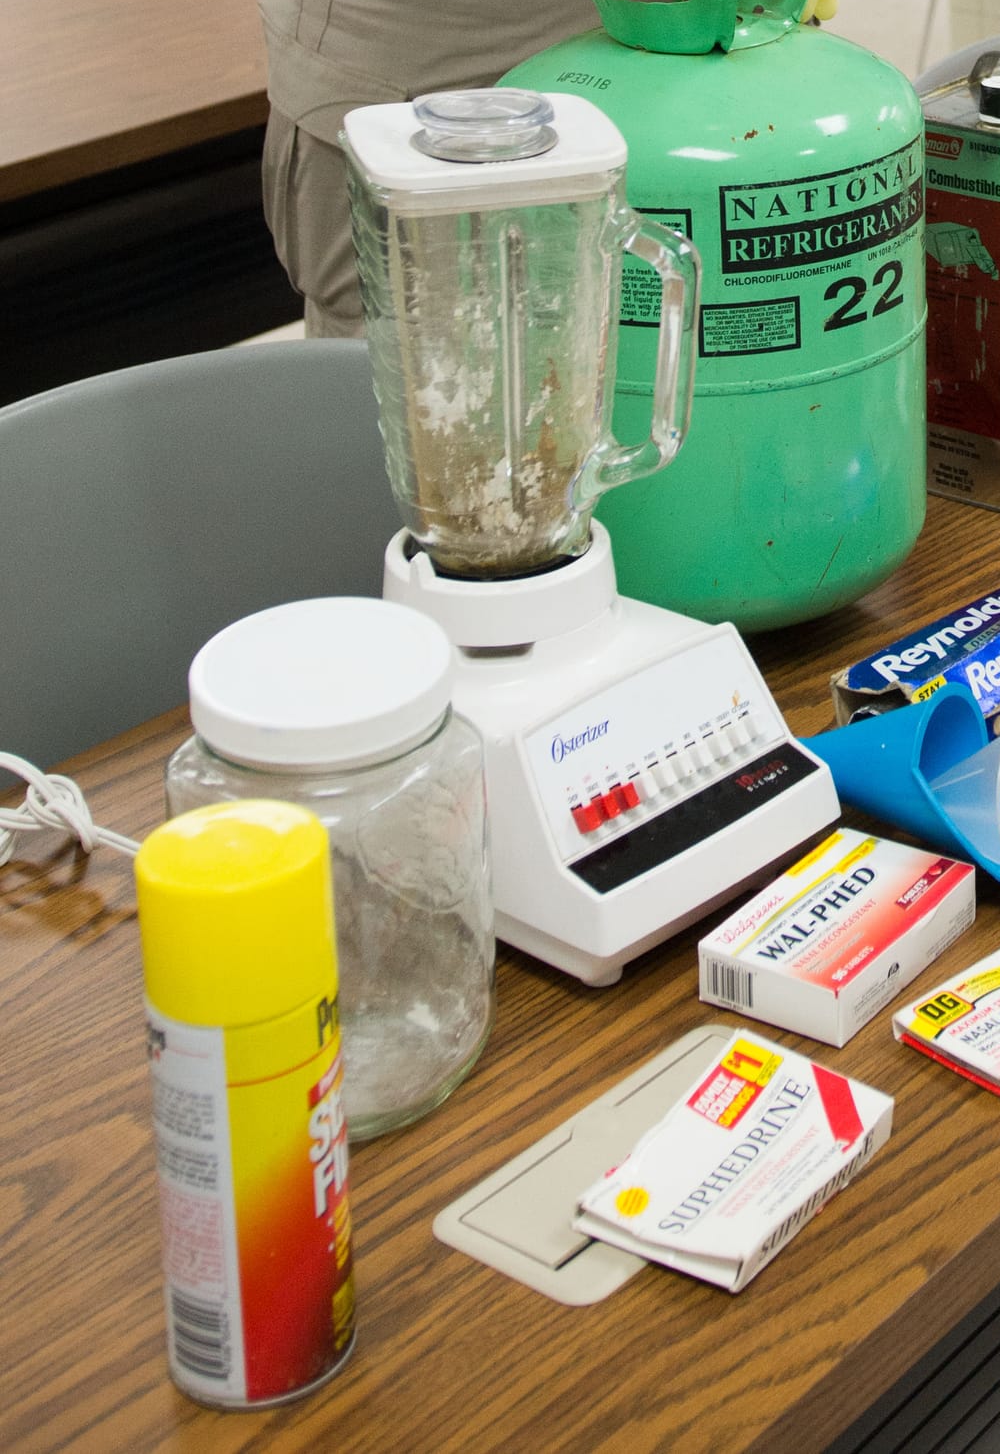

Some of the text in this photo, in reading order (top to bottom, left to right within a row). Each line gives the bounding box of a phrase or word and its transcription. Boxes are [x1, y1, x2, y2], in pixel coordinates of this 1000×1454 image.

[731, 154, 916, 221] NATIONAL
[724, 260, 852, 287] CHLORODIFLUOROMETHANE
[823, 260, 904, 332] 22
[917, 681, 942, 703] STAY
[715, 895, 784, 945] Walgreens
[756, 867, 876, 960] WAL-PHED
[819, 898, 877, 950] DECONGESTANT
[919, 994, 960, 1021] DG
[949, 1007, 993, 1037] MAXIMUM
[693, 1071, 731, 1111] FAMILY
[705, 1076, 747, 1122] DOLLAR
[718, 1085, 757, 1126] SAVINGS
[658, 1078, 811, 1234] SUPHEDRINE
